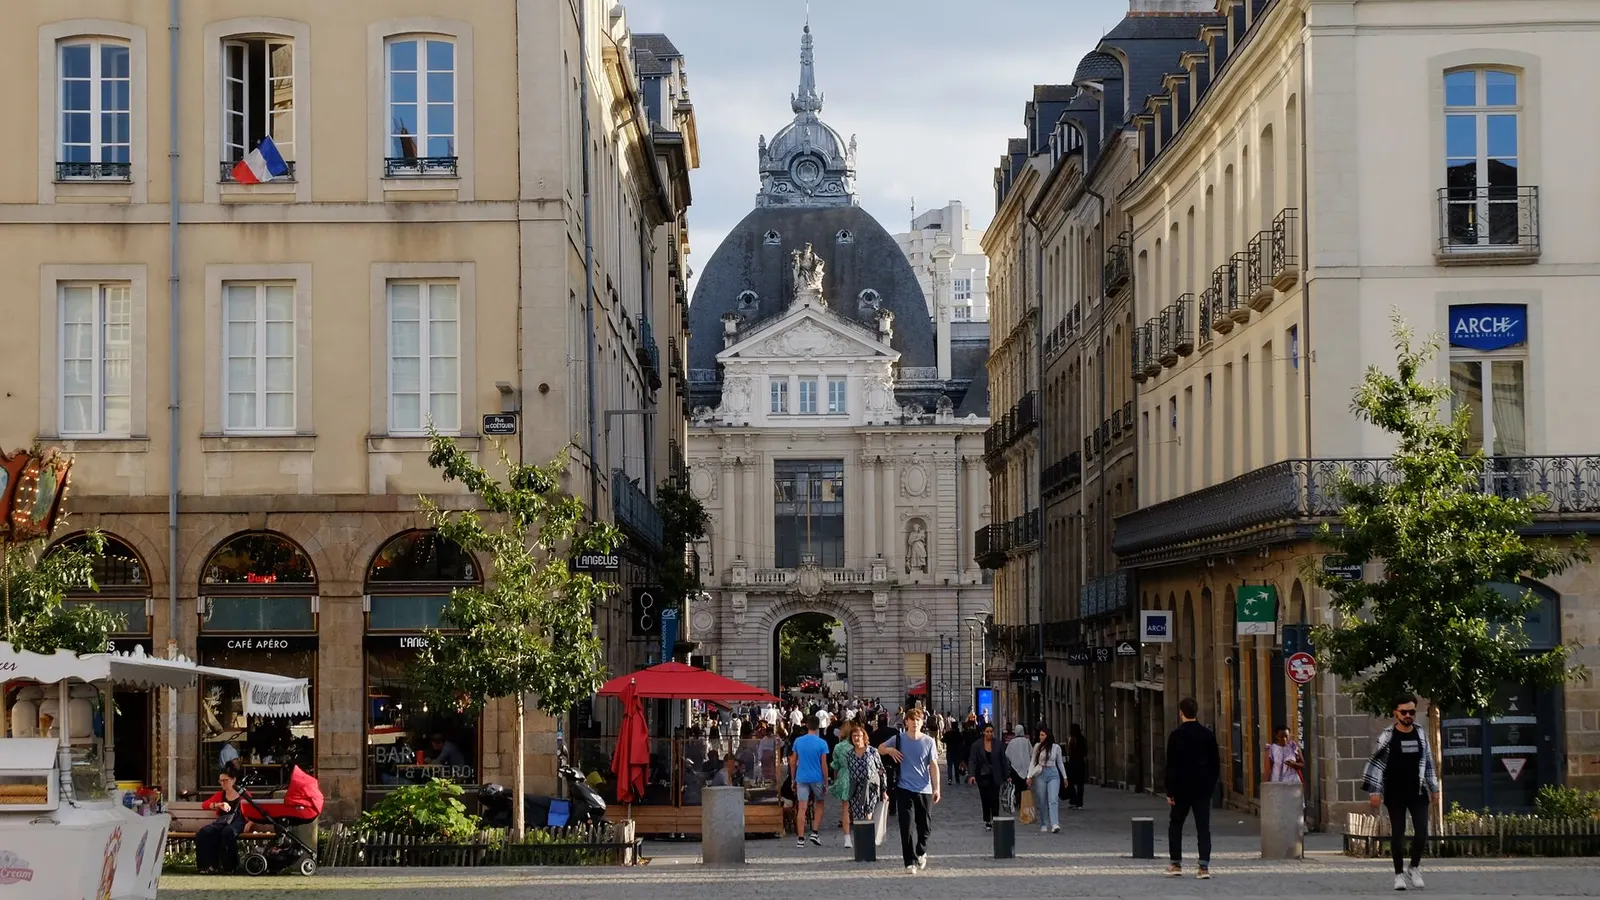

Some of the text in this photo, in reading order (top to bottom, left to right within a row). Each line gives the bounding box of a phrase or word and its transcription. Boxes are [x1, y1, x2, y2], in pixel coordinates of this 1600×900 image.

[227, 639, 288, 649] CAFÉ APÉRO
[376, 747, 412, 763] BAR
[1, 868, 31, 879] Cream
